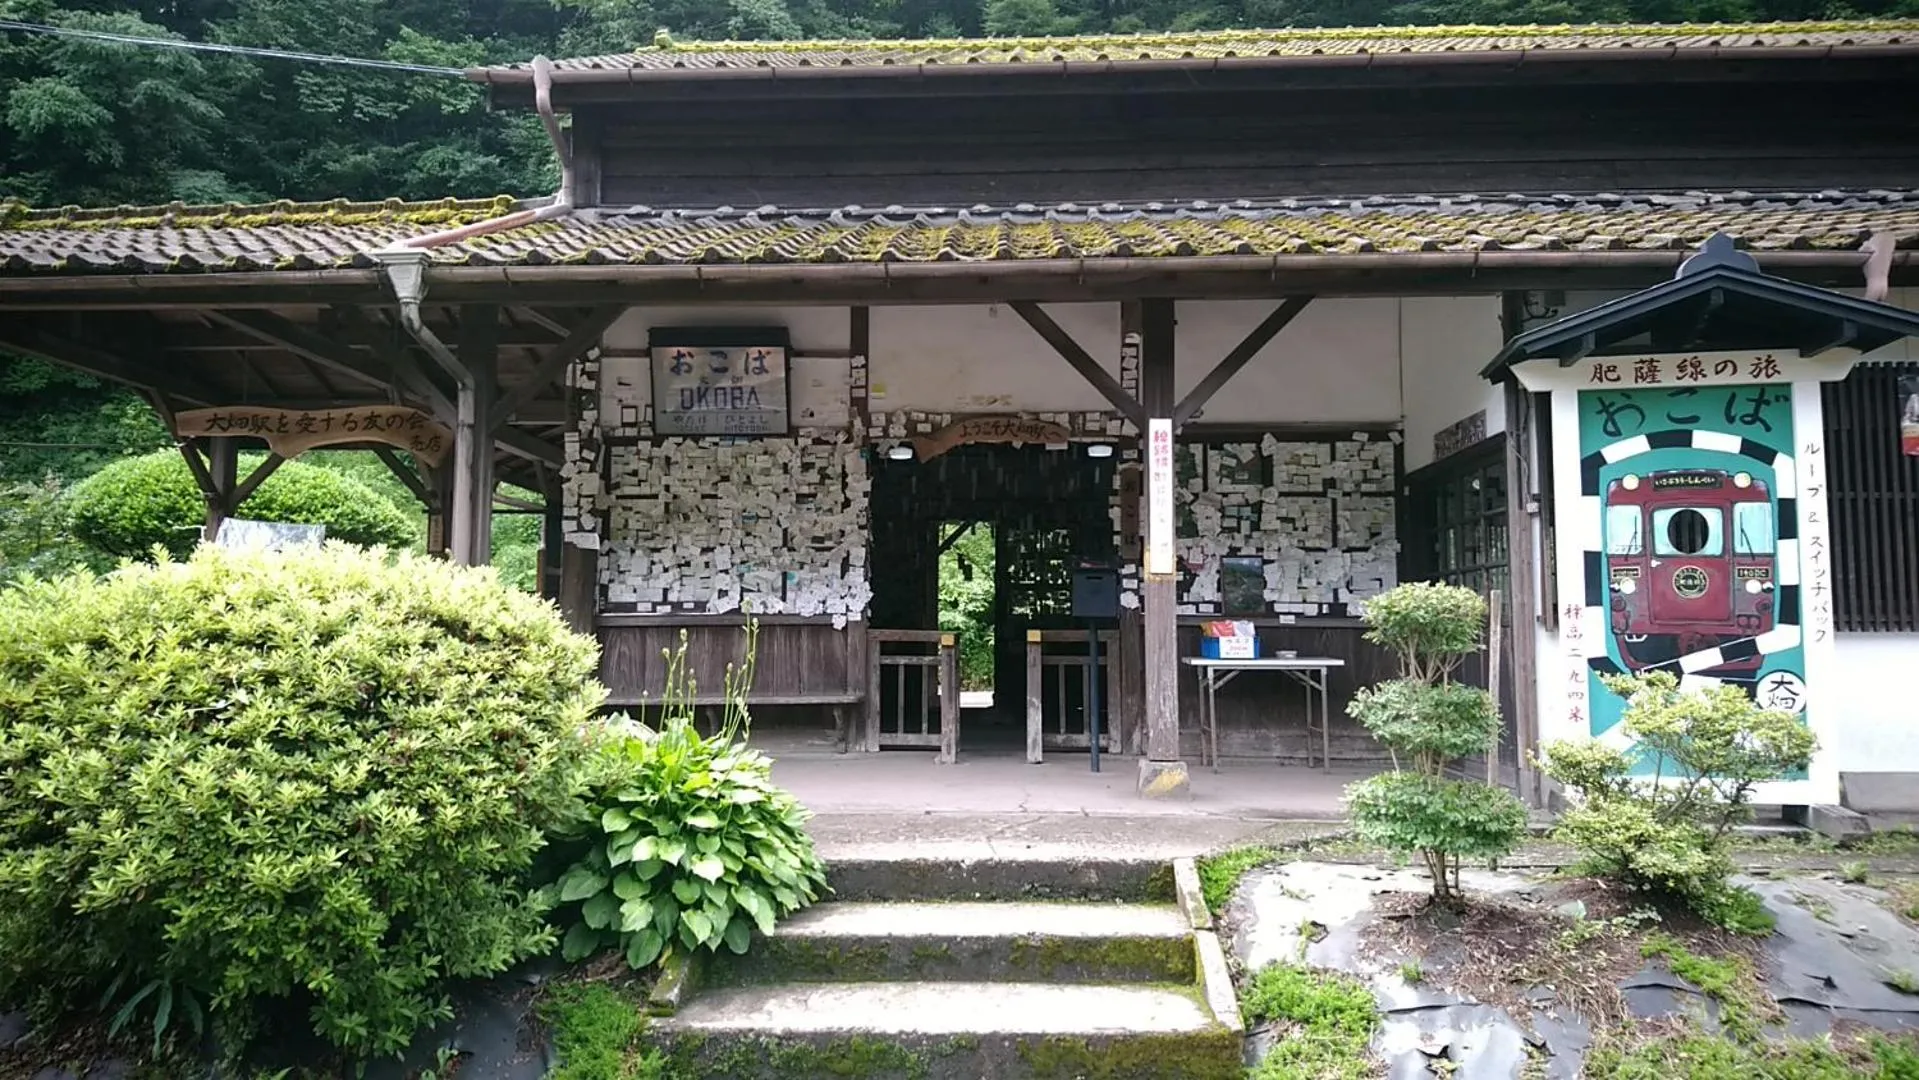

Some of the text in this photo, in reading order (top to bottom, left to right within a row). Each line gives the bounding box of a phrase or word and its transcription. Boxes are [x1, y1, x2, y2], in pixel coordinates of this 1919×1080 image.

[669, 348, 772, 376] おこば
[1589, 355, 1783, 384] 肥薩線の旅
[680, 385, 762, 410] OKOBA
[204, 410, 428, 435] 大畑駅を愛する友の会
[1595, 386, 1792, 438] おこば
[1767, 674, 1802, 710] 大畑
